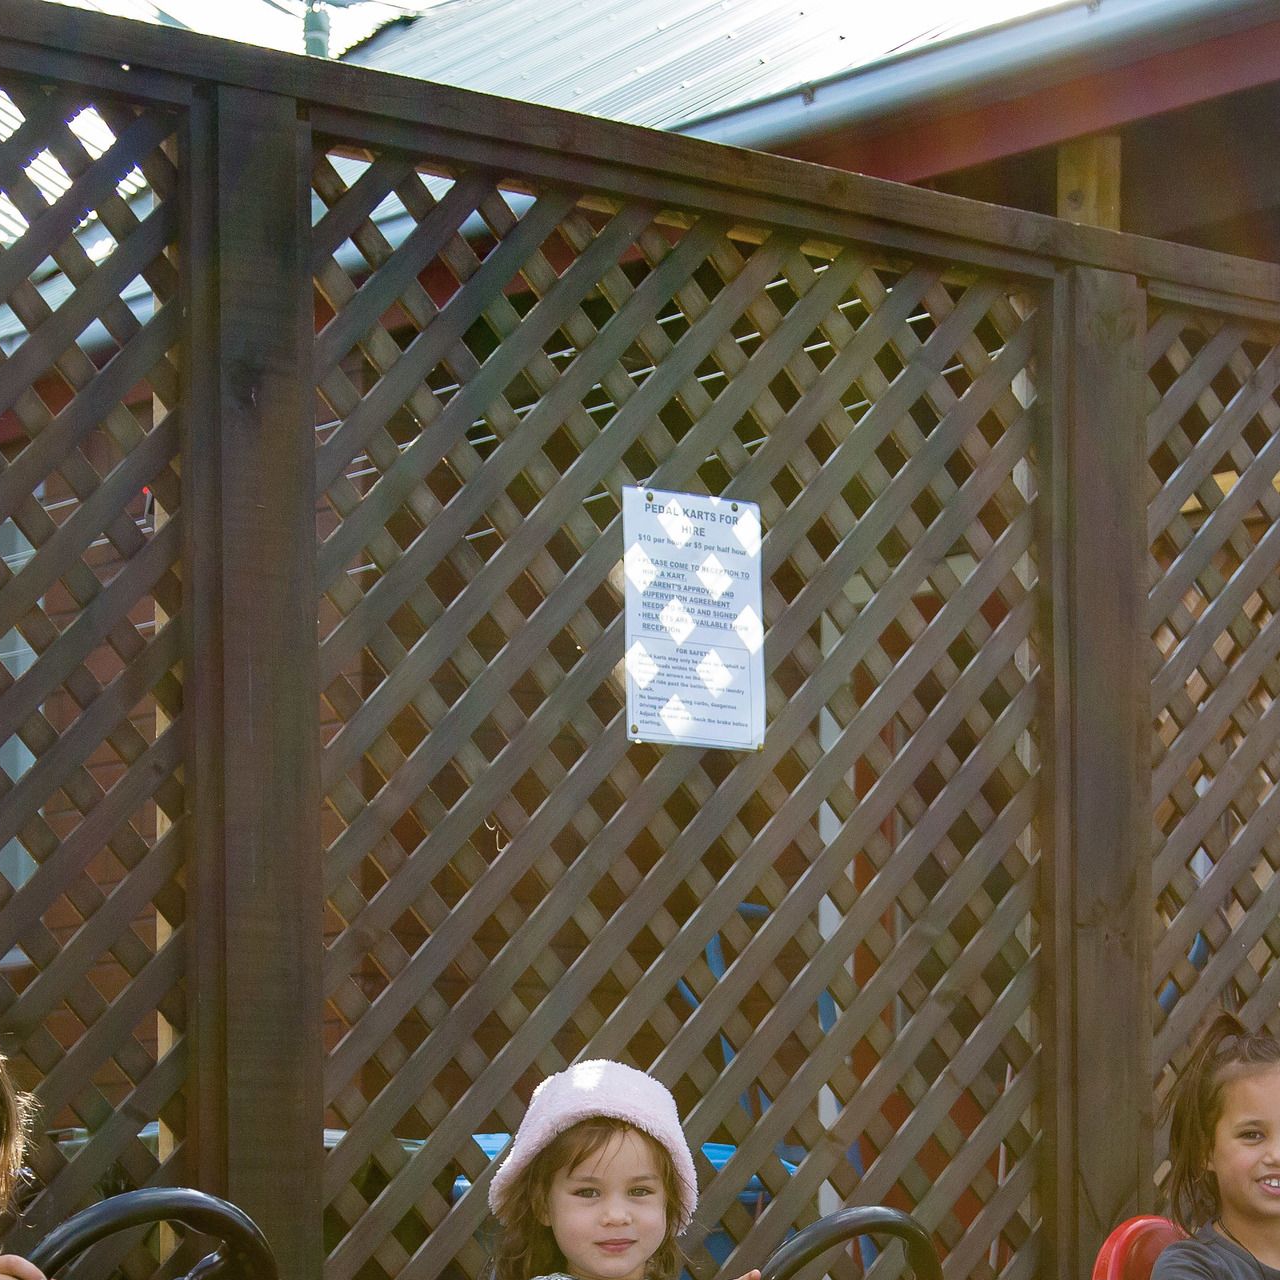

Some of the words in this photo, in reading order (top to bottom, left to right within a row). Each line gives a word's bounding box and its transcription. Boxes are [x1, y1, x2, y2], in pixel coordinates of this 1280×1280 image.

[644, 502, 679, 517] PEDAL
[682, 508, 716, 522] KARTS
[719, 513, 738, 526] FOR
[681, 525, 705, 537] HIRE
[638, 533, 651, 542] $10
[653, 537, 665, 545] per
[694, 541, 702, 550] $5
[704, 545, 716, 553] per
[669, 561, 688, 570] COME
[691, 564, 701, 572] TO
[740, 571, 750, 580] TO
[642, 600, 664, 610] NEEDS
[697, 608, 711, 616] AND
[689, 596, 730, 609] AGREEMENT
